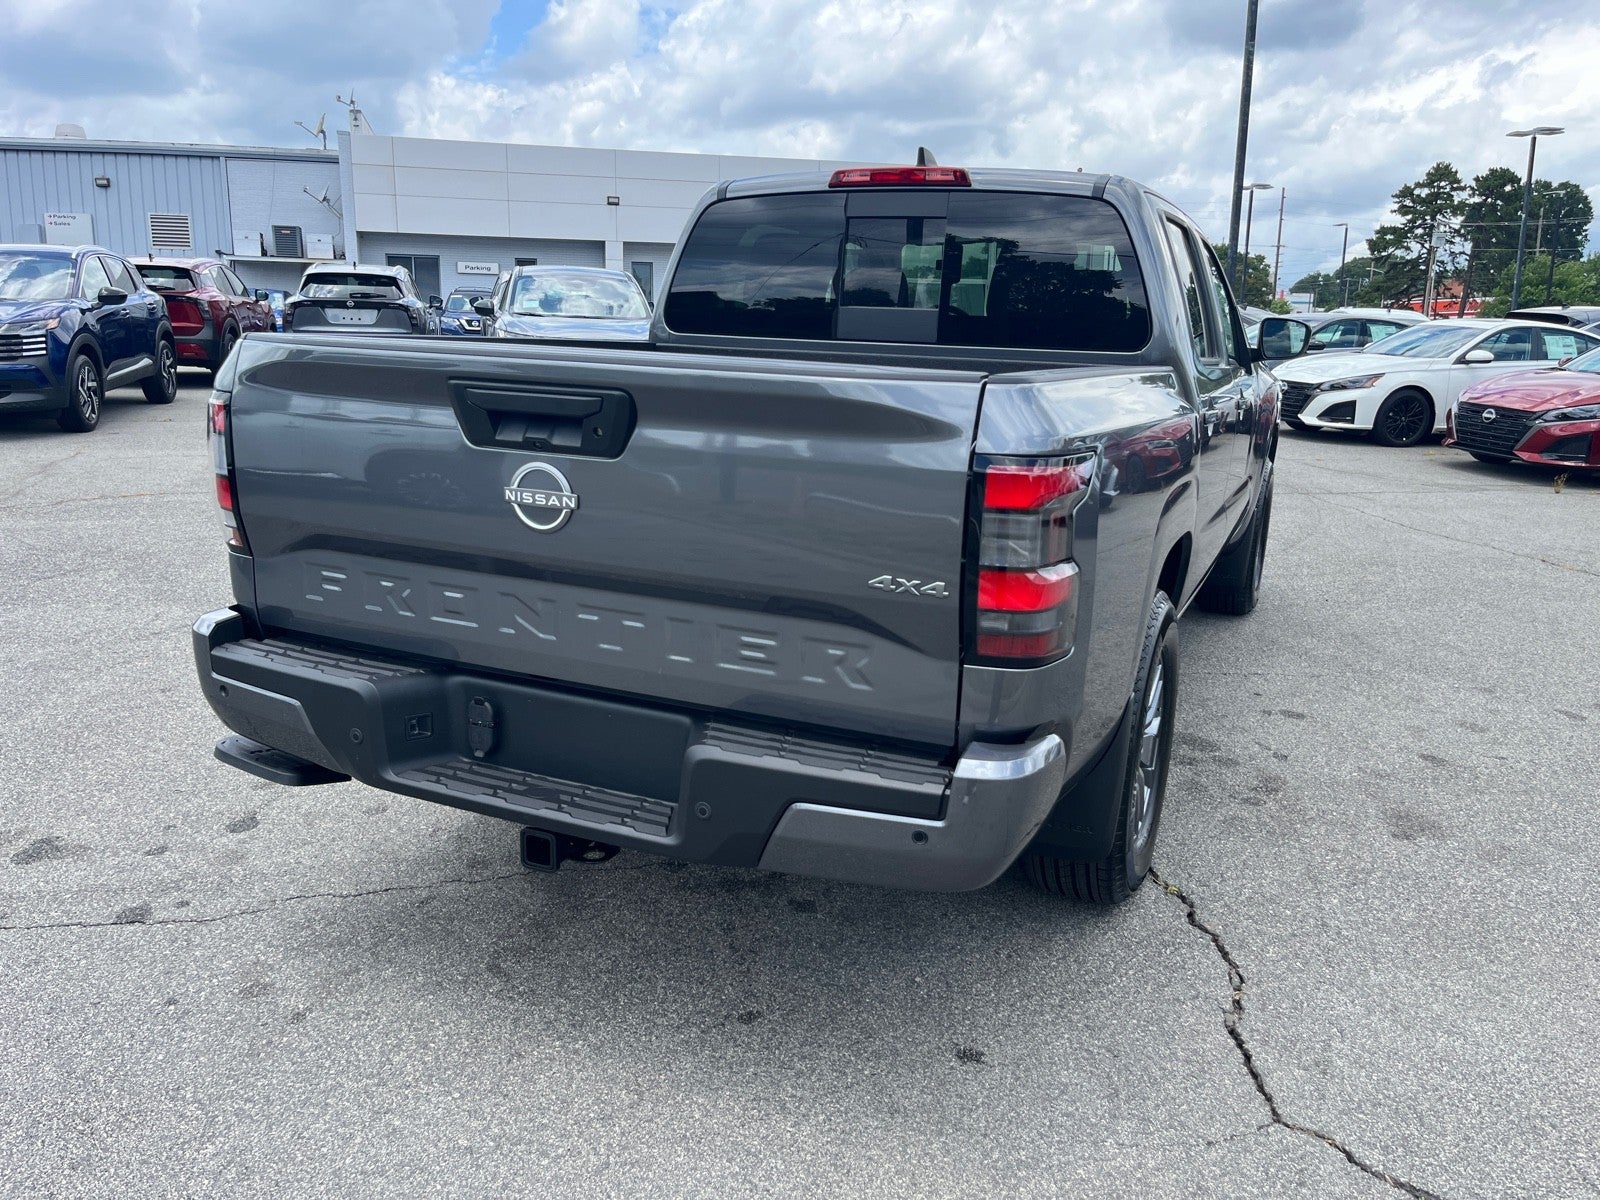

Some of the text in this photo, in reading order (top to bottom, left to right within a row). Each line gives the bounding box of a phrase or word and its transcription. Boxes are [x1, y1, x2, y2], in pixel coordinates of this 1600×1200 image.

[464, 264, 492, 272] Parking
[505, 489, 575, 508] NISSAN
[301, 561, 876, 692] FRONTIER
